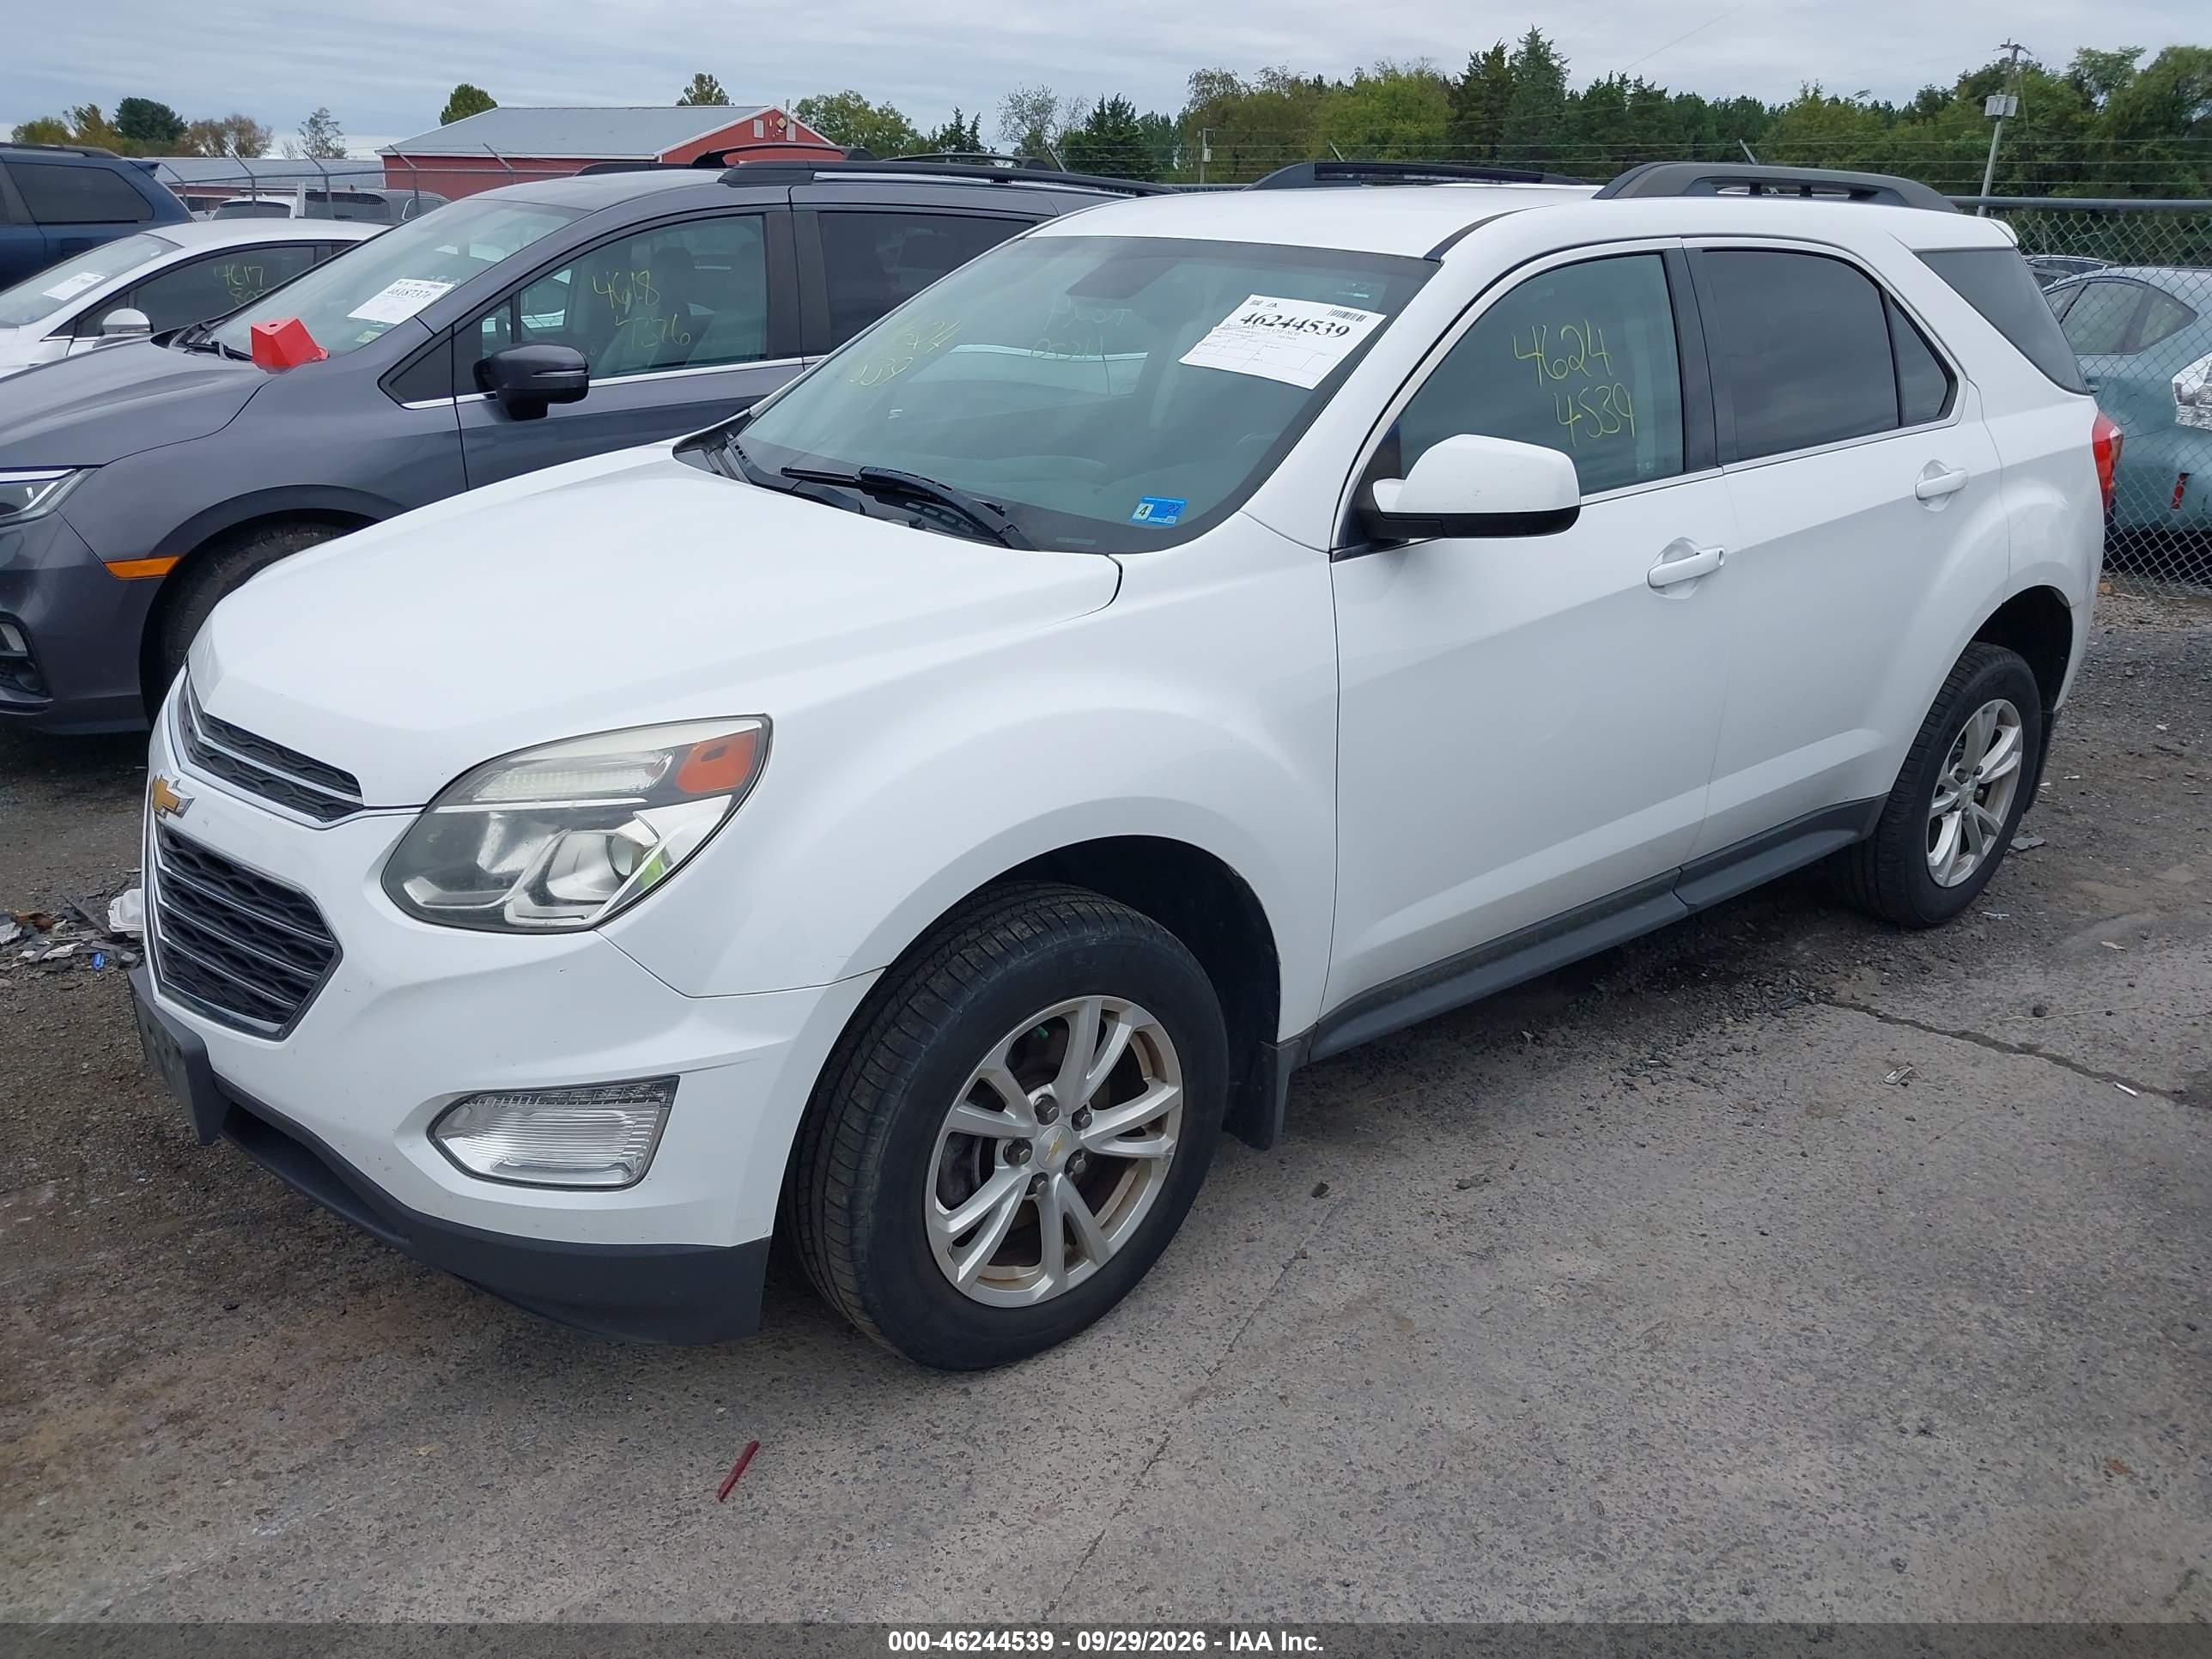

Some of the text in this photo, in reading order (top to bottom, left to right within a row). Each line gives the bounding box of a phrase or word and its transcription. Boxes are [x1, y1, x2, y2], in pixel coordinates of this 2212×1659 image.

[1239, 312, 1351, 338] 46244539
[1512, 319, 1613, 387] 4624
[1552, 382, 1635, 447] 4539
[1139, 505, 1149, 517] 4
